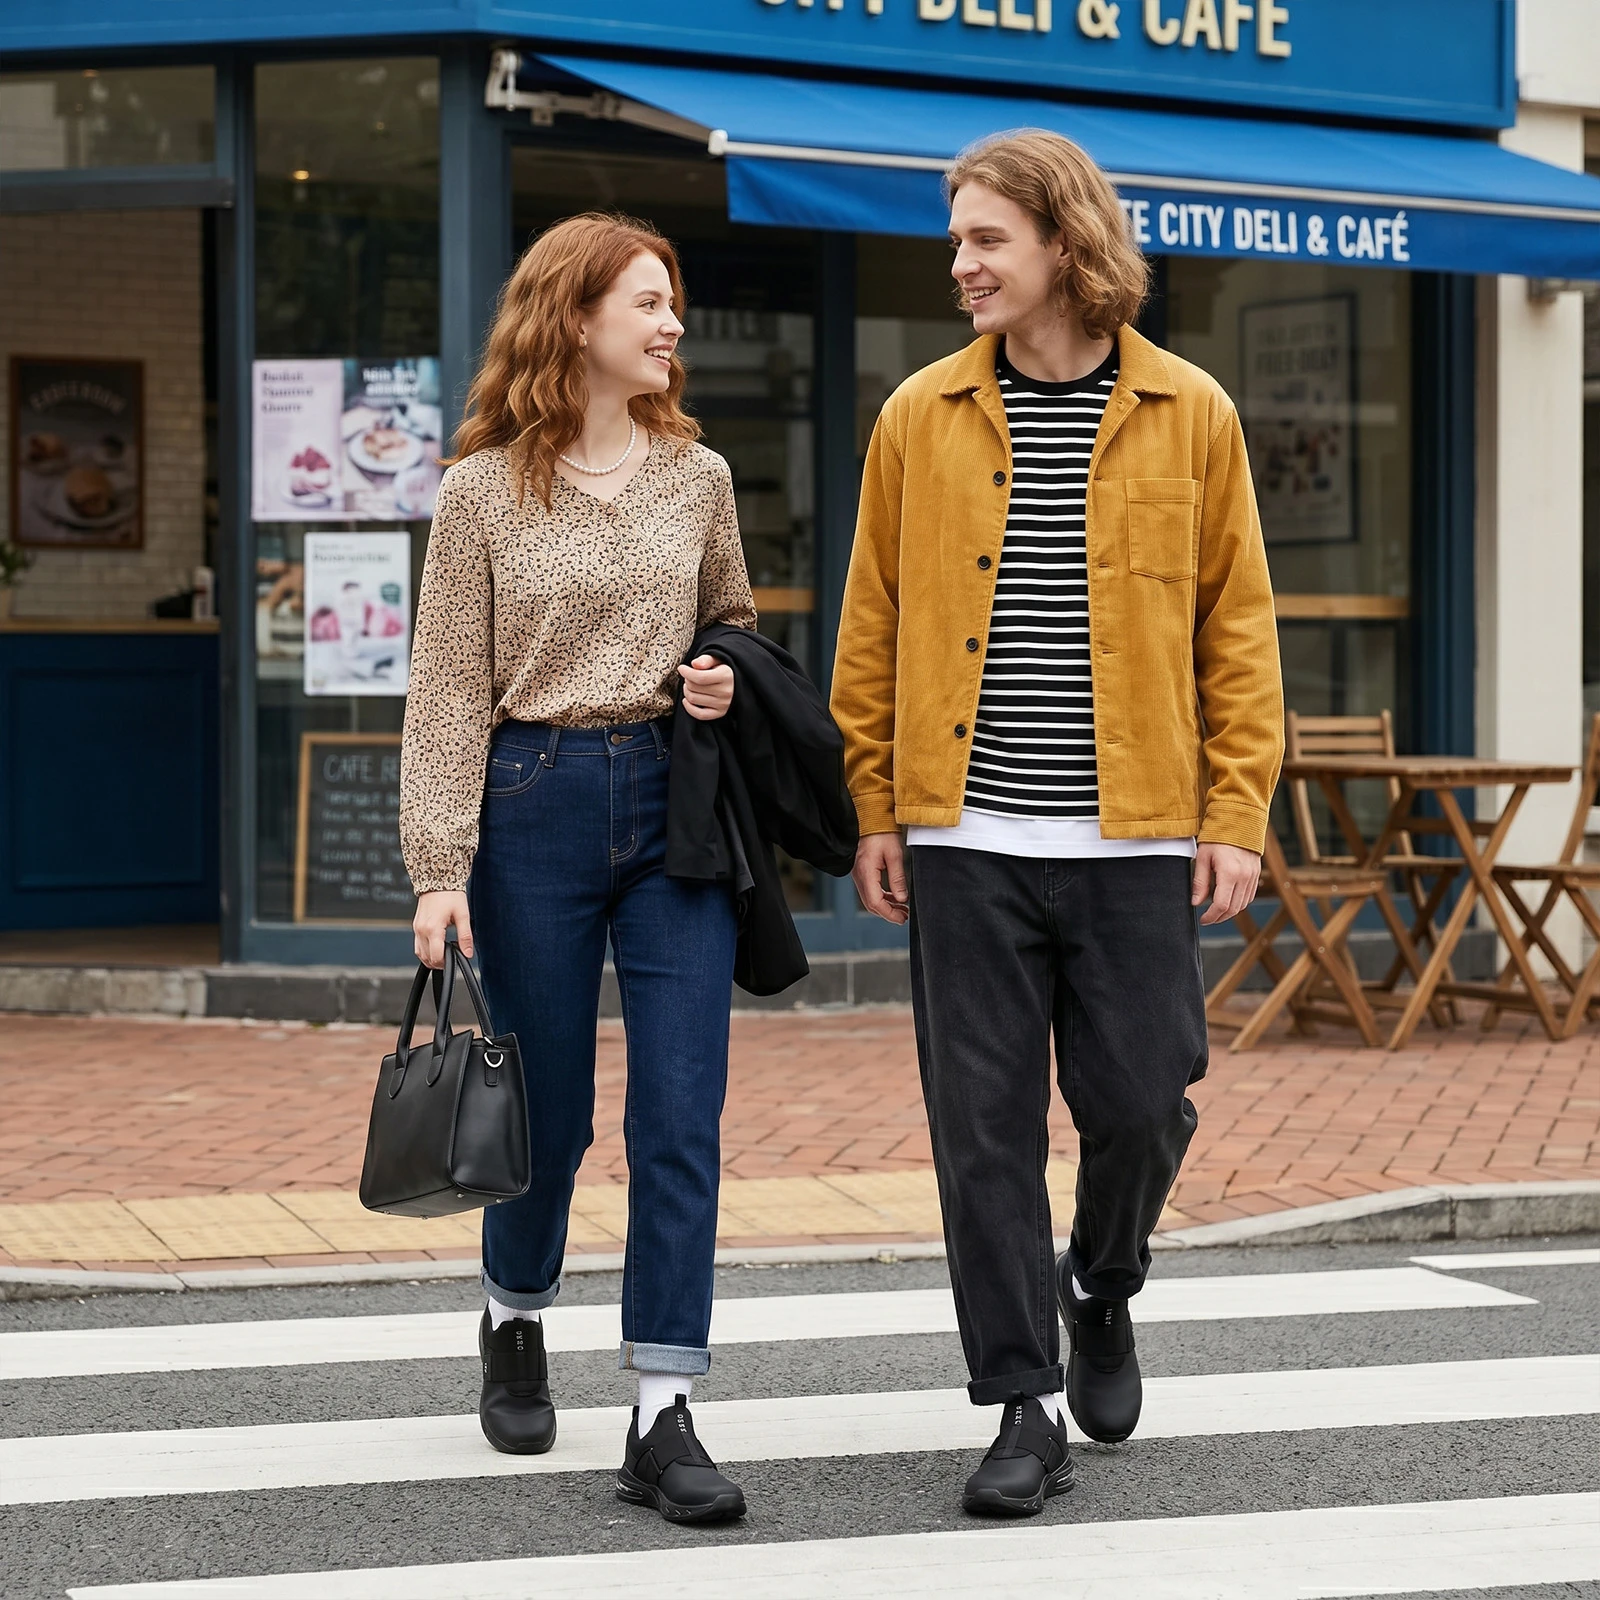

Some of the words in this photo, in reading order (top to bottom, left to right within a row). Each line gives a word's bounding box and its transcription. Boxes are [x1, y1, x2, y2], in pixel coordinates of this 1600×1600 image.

[1158, 202, 1225, 249] CITY
[1233, 207, 1299, 254] DELI
[1306, 214, 1329, 257] &
[1336, 210, 1411, 262] CAFÉ
